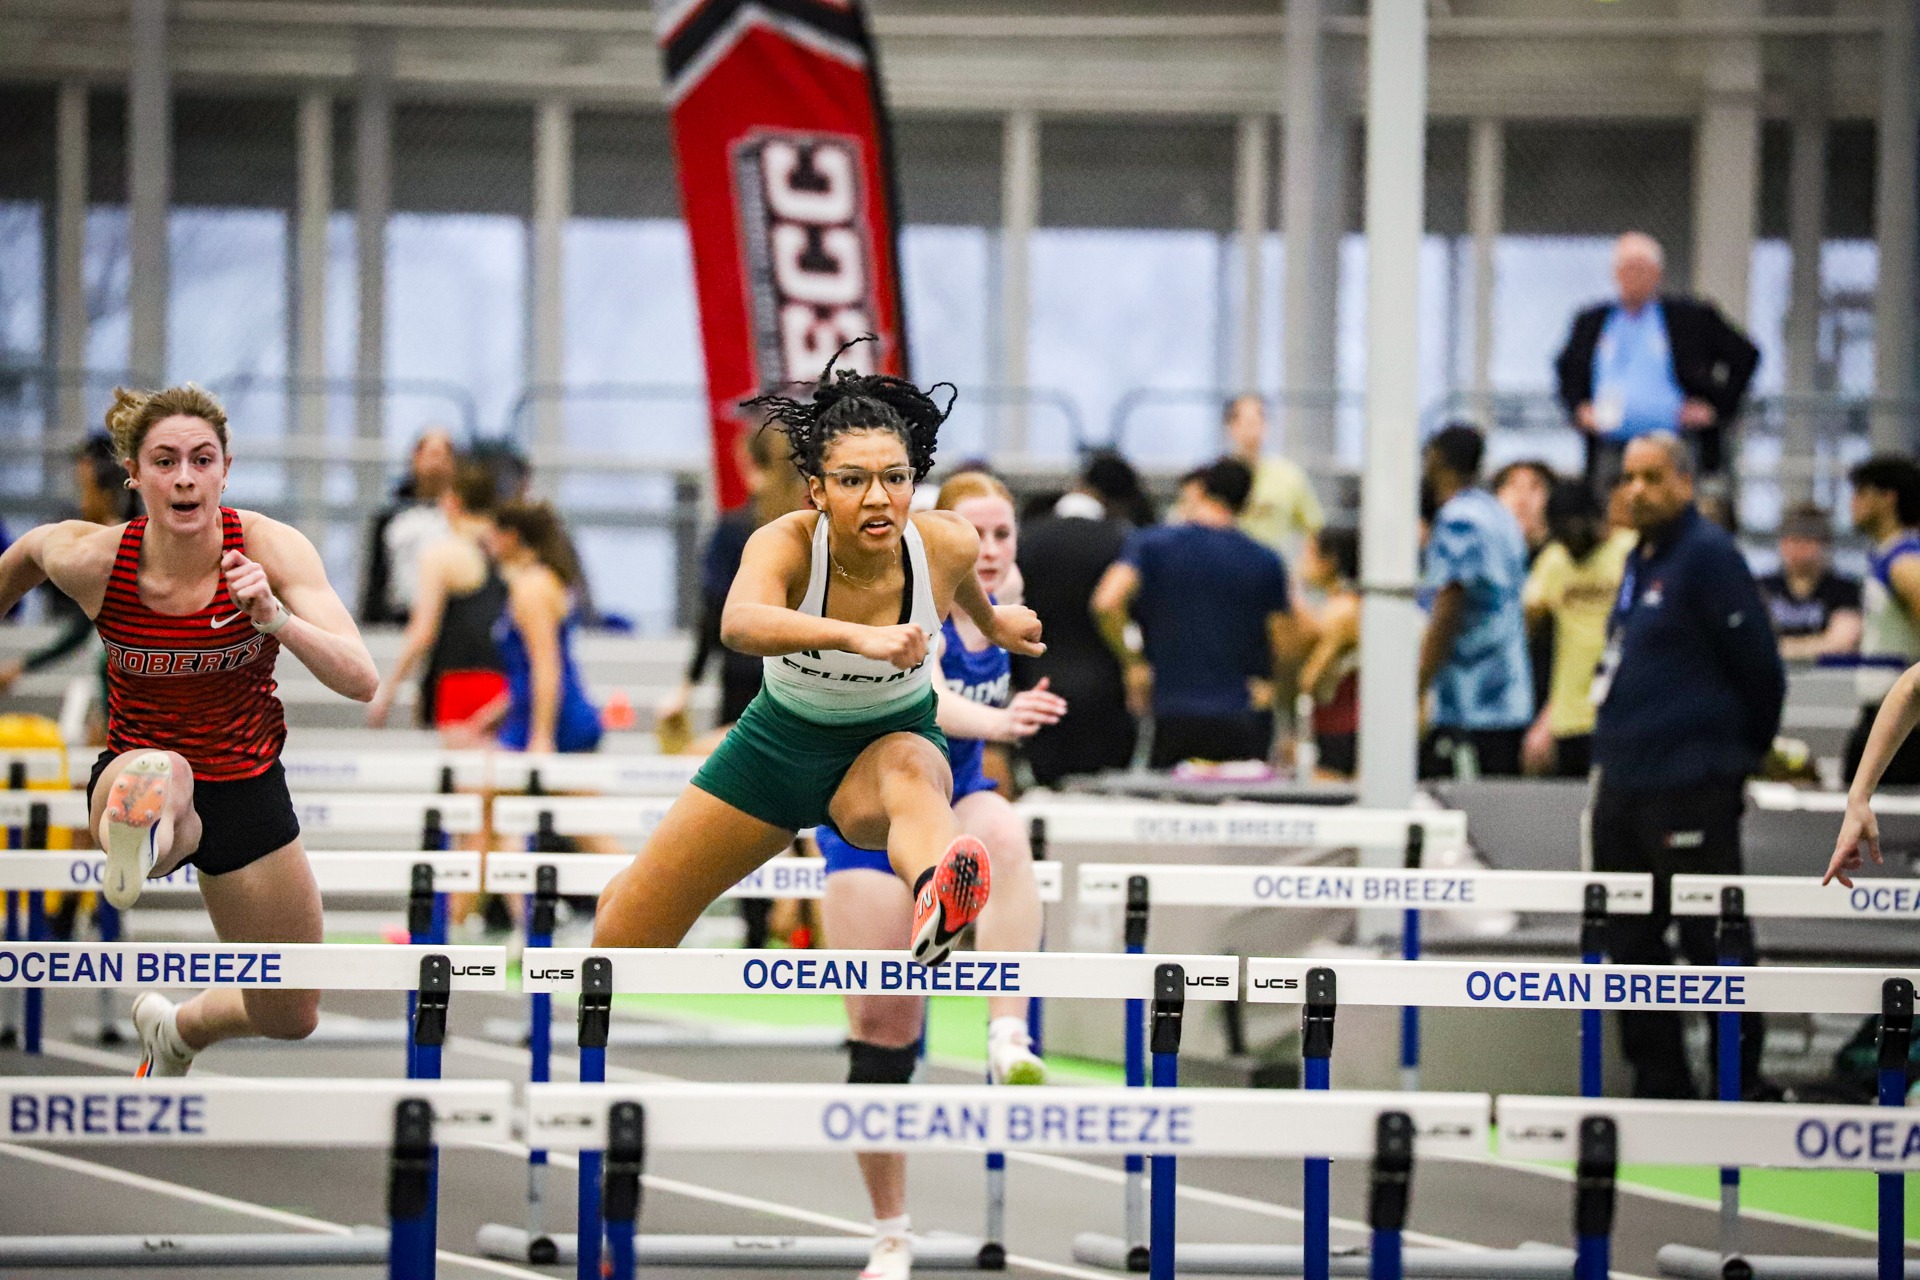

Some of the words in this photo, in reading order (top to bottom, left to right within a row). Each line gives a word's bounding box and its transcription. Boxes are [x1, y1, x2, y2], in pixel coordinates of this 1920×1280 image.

[105, 635, 265, 674] ROBERTS
[1253, 875, 1352, 899] OCEAN
[1363, 878, 1475, 902] BREEZE
[0, 951, 123, 983] OCEAN
[136, 952, 282, 983] BREEZE
[451, 965, 497, 977] UCS
[530, 968, 576, 980] UCS
[743, 958, 868, 990] OCEAN
[880, 960, 1021, 992] BREEZE
[1185, 975, 1230, 987] UCS
[1254, 977, 1299, 989] UCS
[1465, 970, 1591, 1002] OCEAN
[1603, 973, 1746, 1005] BREEZE
[10, 1094, 207, 1134] BREEZE
[823, 1102, 990, 1142] OCEAN
[1006, 1104, 1194, 1145] BREEZE
